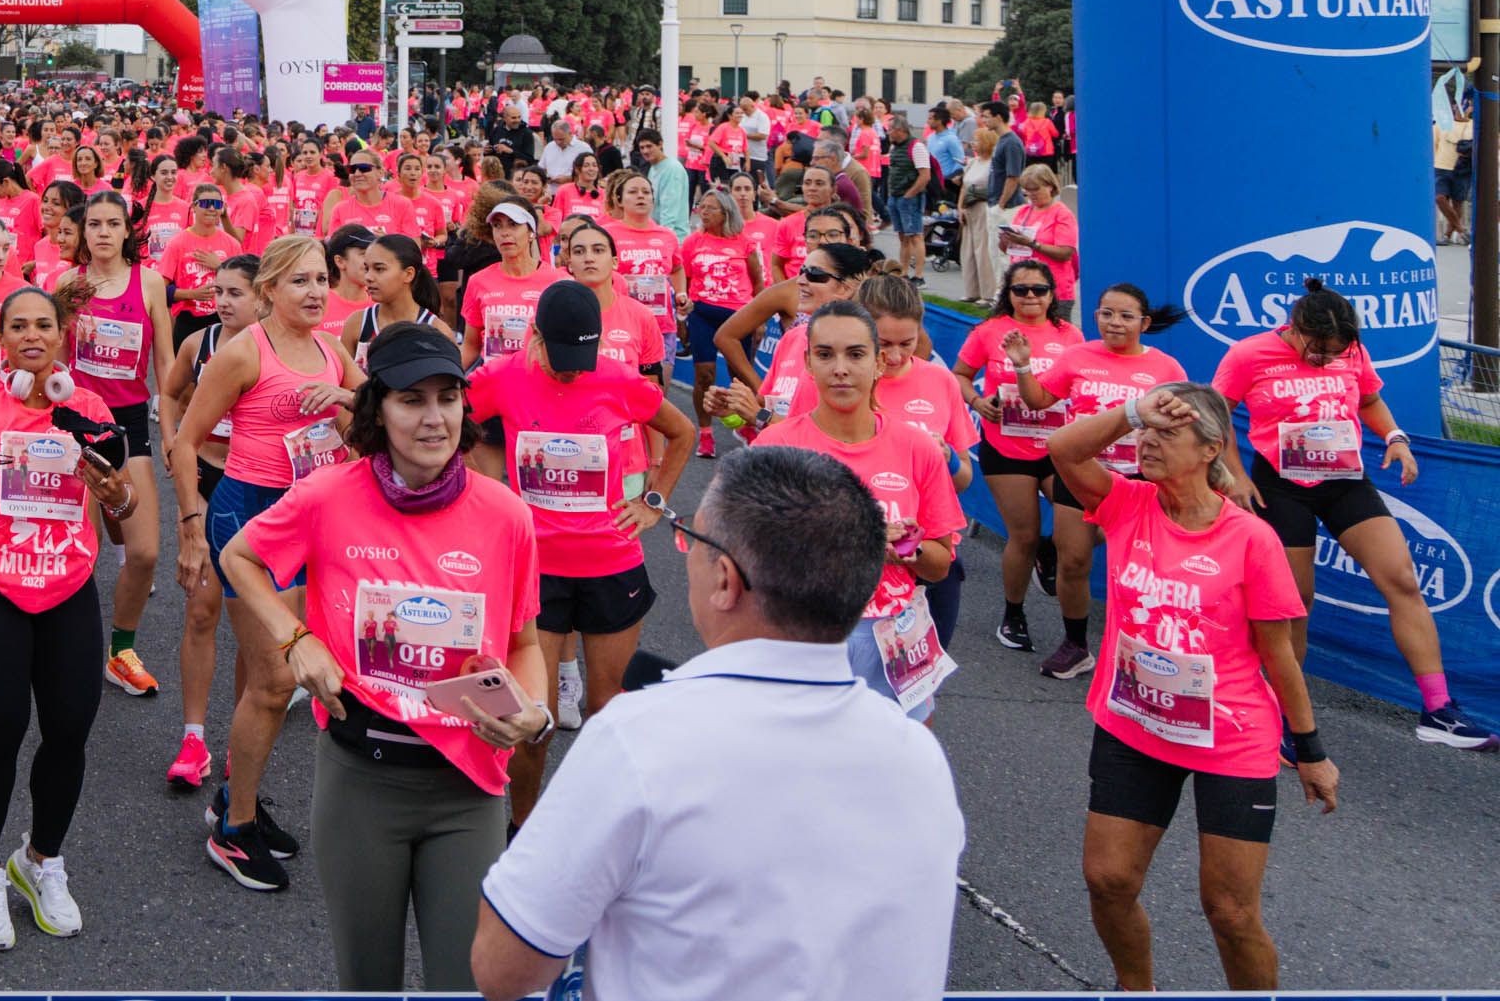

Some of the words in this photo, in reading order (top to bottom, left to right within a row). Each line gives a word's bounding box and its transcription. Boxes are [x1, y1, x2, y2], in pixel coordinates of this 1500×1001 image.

[324, 81, 384, 92] CORREDORAS
[94, 344, 120, 358] 016
[1273, 376, 1347, 399] CARRERA
[313, 450, 336, 467] 016
[1306, 450, 1338, 461] 016
[28, 471, 62, 488] 016
[545, 469, 579, 483] 016
[346, 545, 399, 561] OYSHO
[0, 551, 67, 576] MUJER
[400, 604, 449, 621] ASTURIANA
[398, 643, 446, 668] 016
[907, 637, 930, 665] 016
[1136, 654, 1178, 676] ASTURIANA
[369, 668, 398, 682] CARRERA
[1137, 683, 1176, 709] 016
